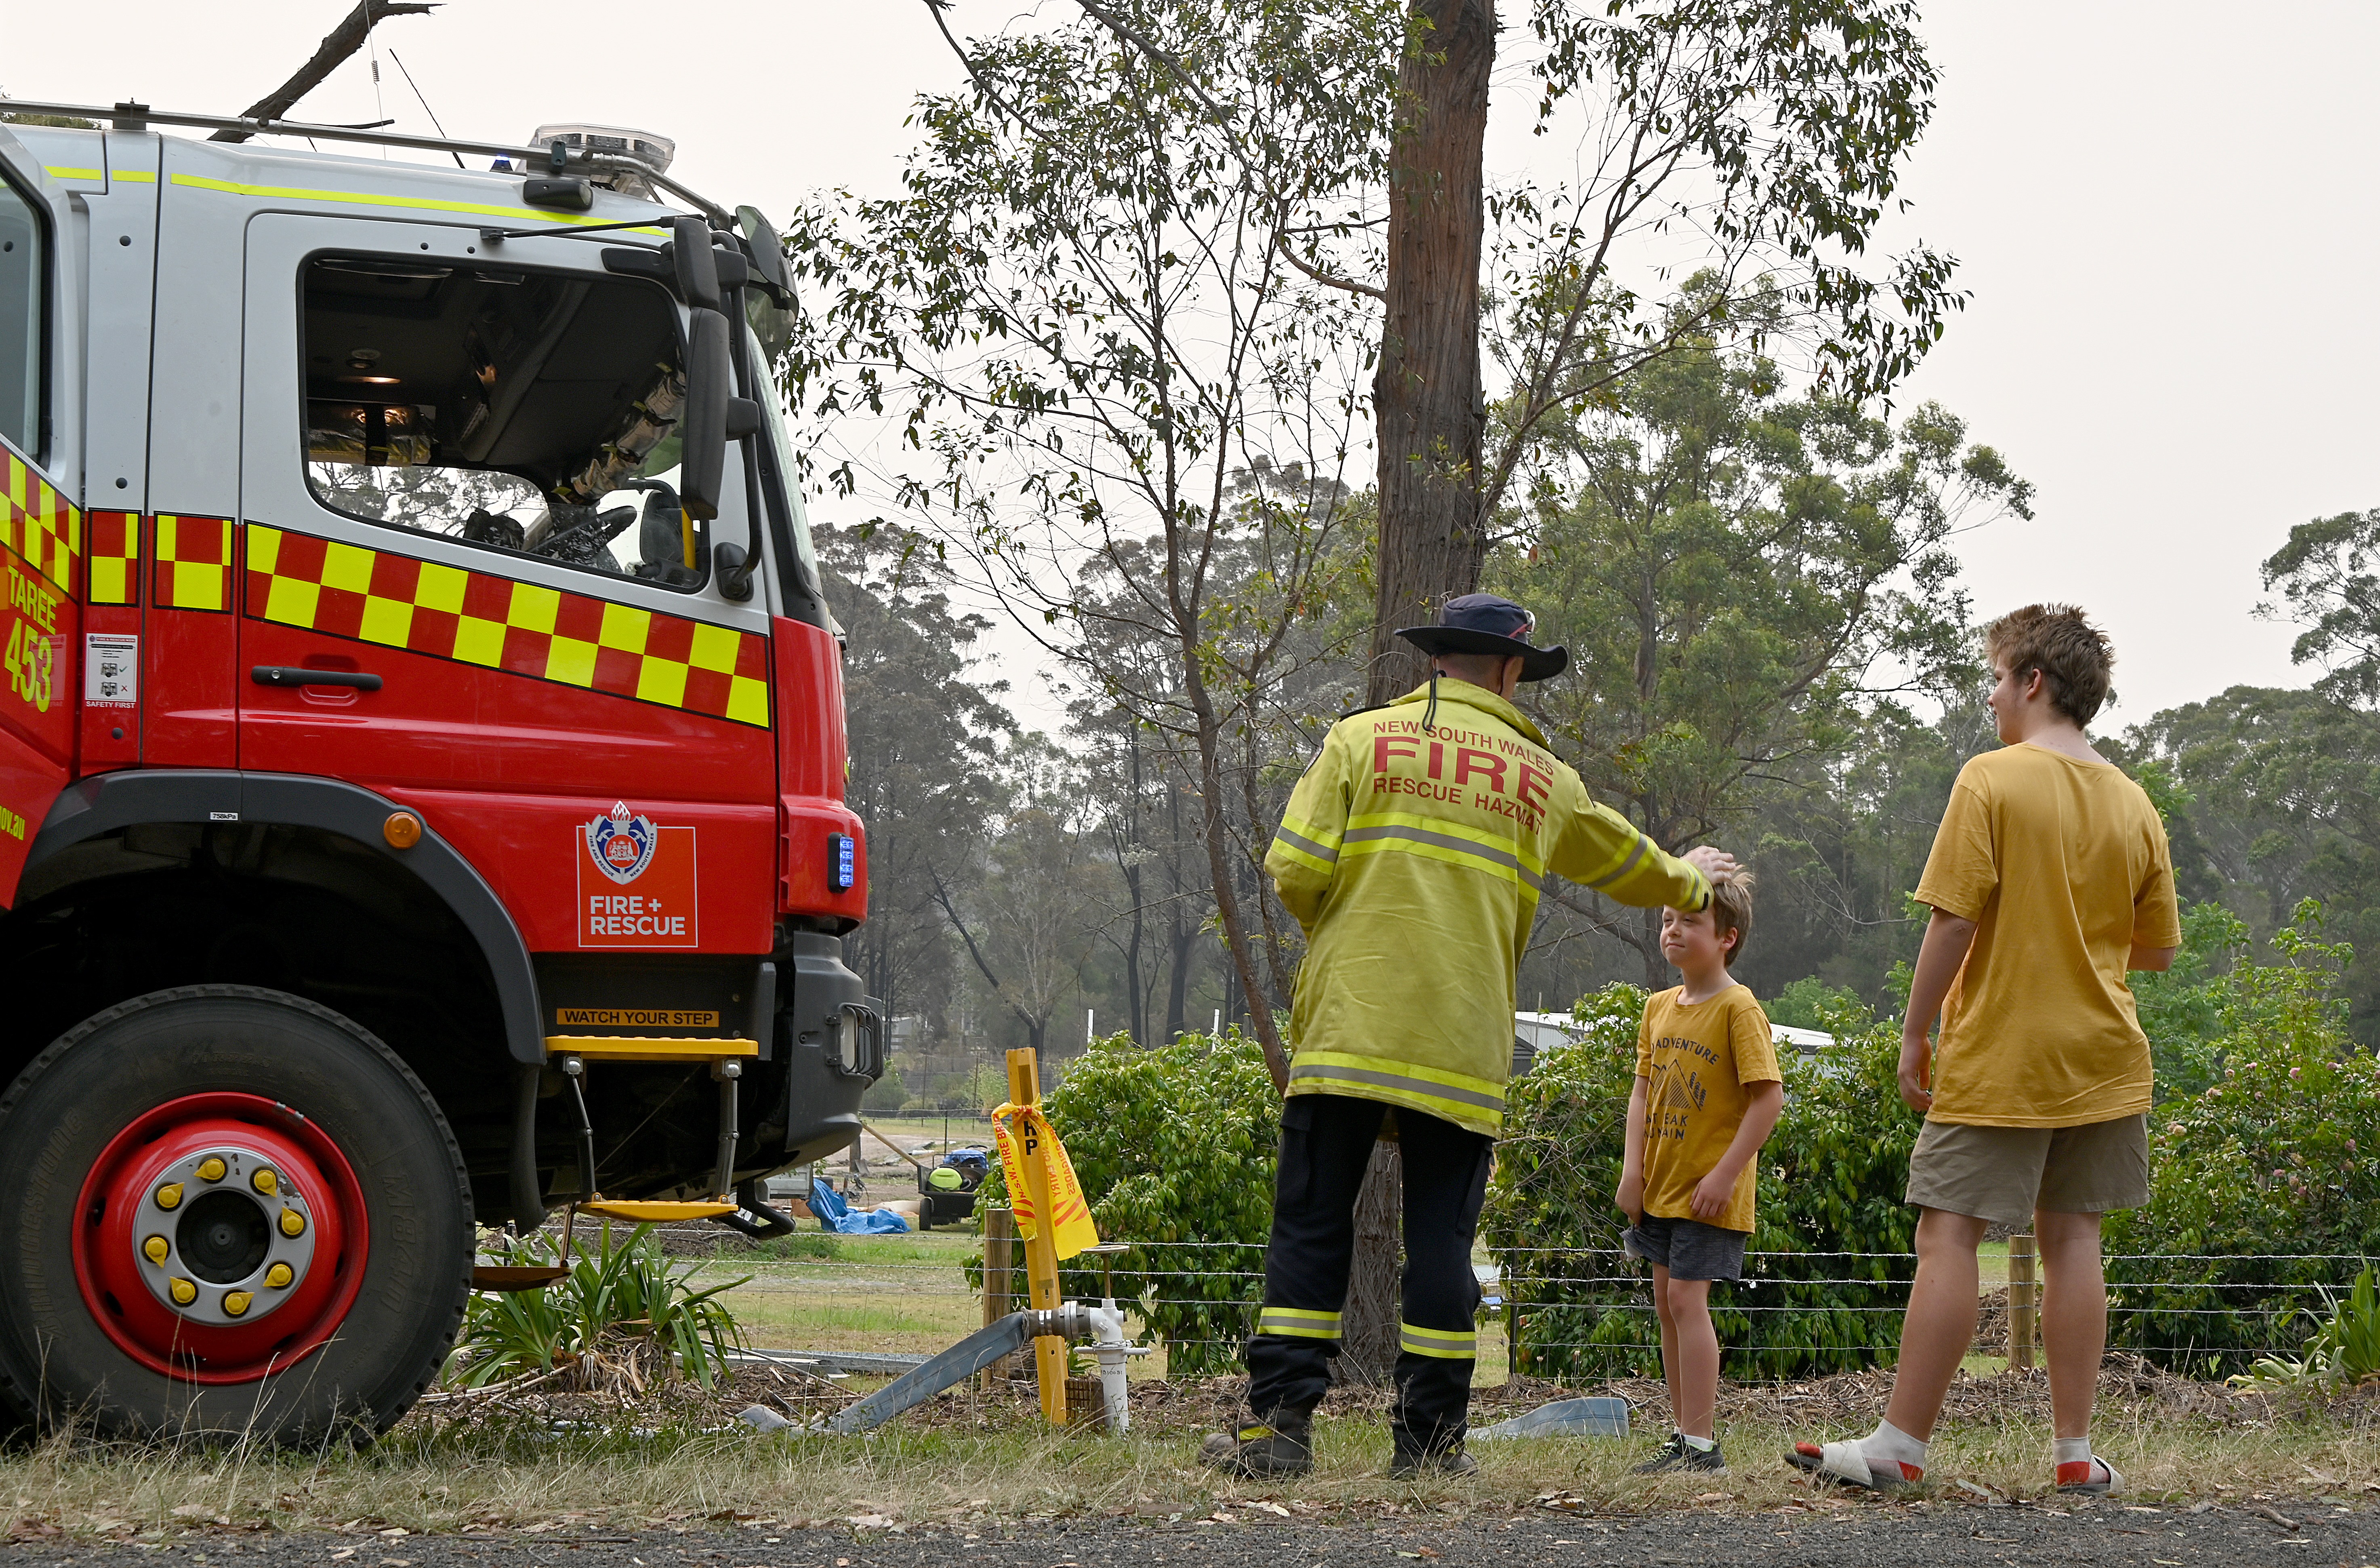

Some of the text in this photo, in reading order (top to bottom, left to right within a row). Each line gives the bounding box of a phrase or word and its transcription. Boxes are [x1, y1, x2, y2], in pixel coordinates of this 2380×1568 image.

[8, 565, 57, 635] TAREE
[5, 617, 53, 713] 453
[1374, 721, 1554, 775] NEW SOUTH WALES
[1374, 737, 1553, 818] FIRE
[1374, 777, 1542, 835] RESCUE HAZMAT
[598, 860, 615, 877] RESCUE
[630, 868, 640, 877] NEW
[640, 852, 651, 869] SOUTH
[591, 896, 643, 914] FIRE
[591, 916, 685, 935] RESCUE
[565, 1011, 713, 1025] WATCH YOUR STEP
[1655, 1037, 1720, 1065] ADVENTURE
[999, 1141, 1013, 1166] FIRE
[1008, 1168, 1027, 1199] N.S.W.
[19, 1107, 84, 1341] BRIDGESTONE
